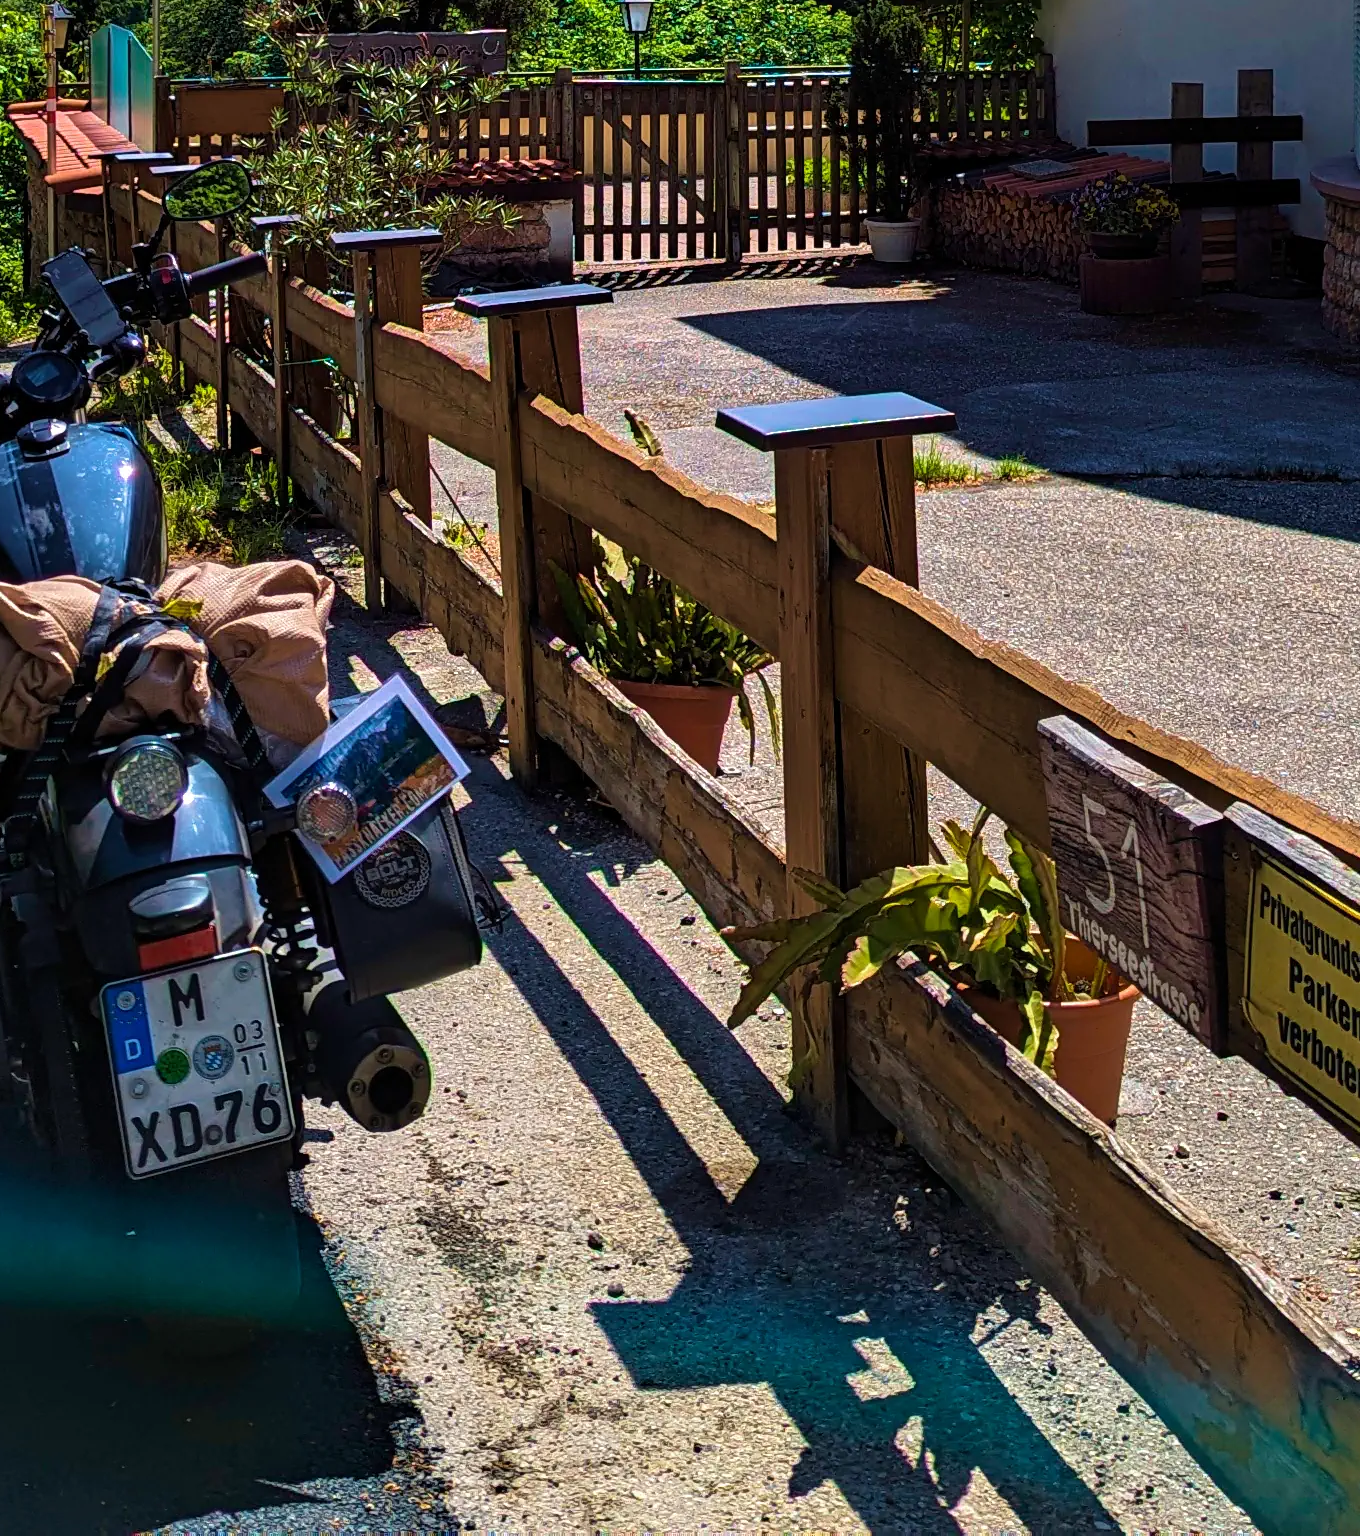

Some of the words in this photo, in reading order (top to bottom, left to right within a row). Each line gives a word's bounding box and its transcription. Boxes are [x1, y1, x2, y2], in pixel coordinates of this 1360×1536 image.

[366, 855, 416, 881] BOLT
[1082, 793, 1151, 949] 51
[1064, 893, 1201, 1032] Thierseestrasse
[168, 972, 205, 1027] M
[124, 1038, 142, 1061] D
[233, 1019, 265, 1044] 03
[241, 1051, 268, 1076] 11
[132, 1102, 203, 1169] XD
[214, 1082, 282, 1144] 76
